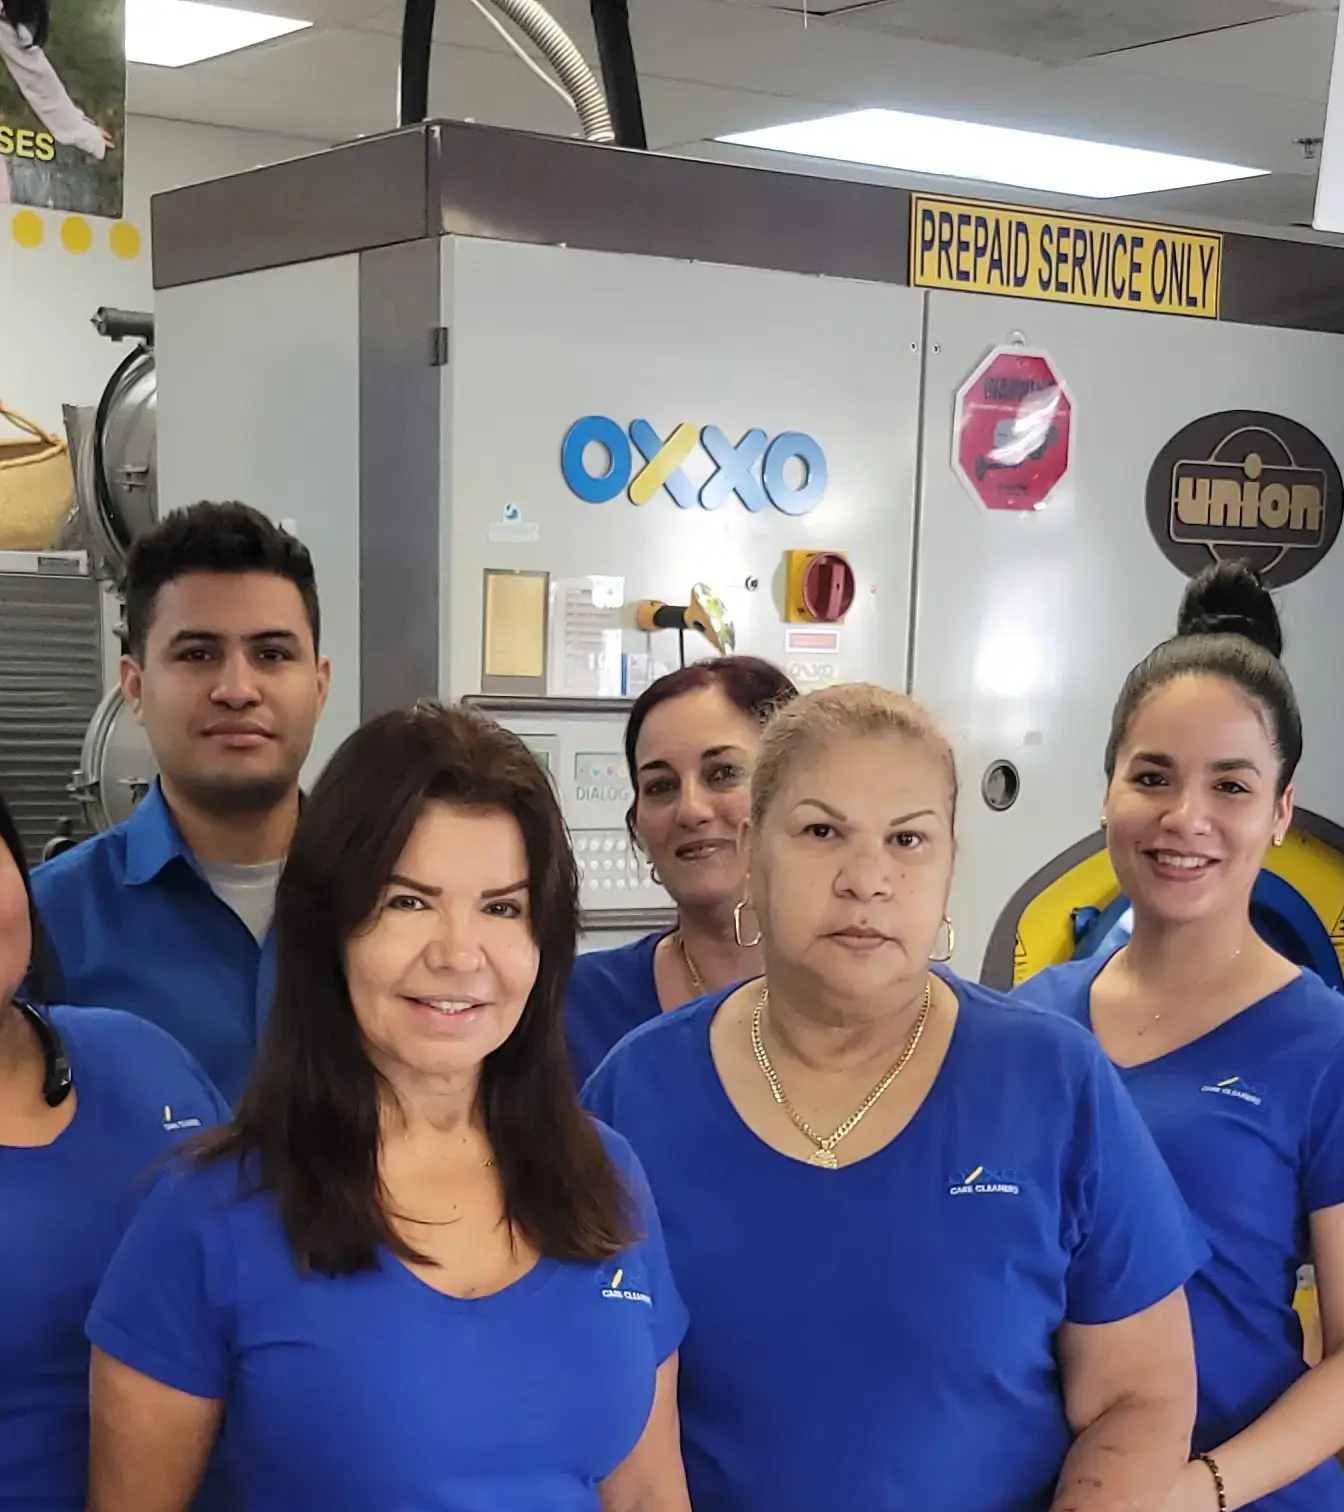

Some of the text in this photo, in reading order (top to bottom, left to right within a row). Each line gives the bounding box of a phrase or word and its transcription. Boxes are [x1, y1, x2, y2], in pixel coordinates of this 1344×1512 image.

[920, 208, 1215, 309] PREPAID SERVICE ONLY
[560, 414, 828, 516] OXXO
[575, 785, 628, 801] DIALOG
